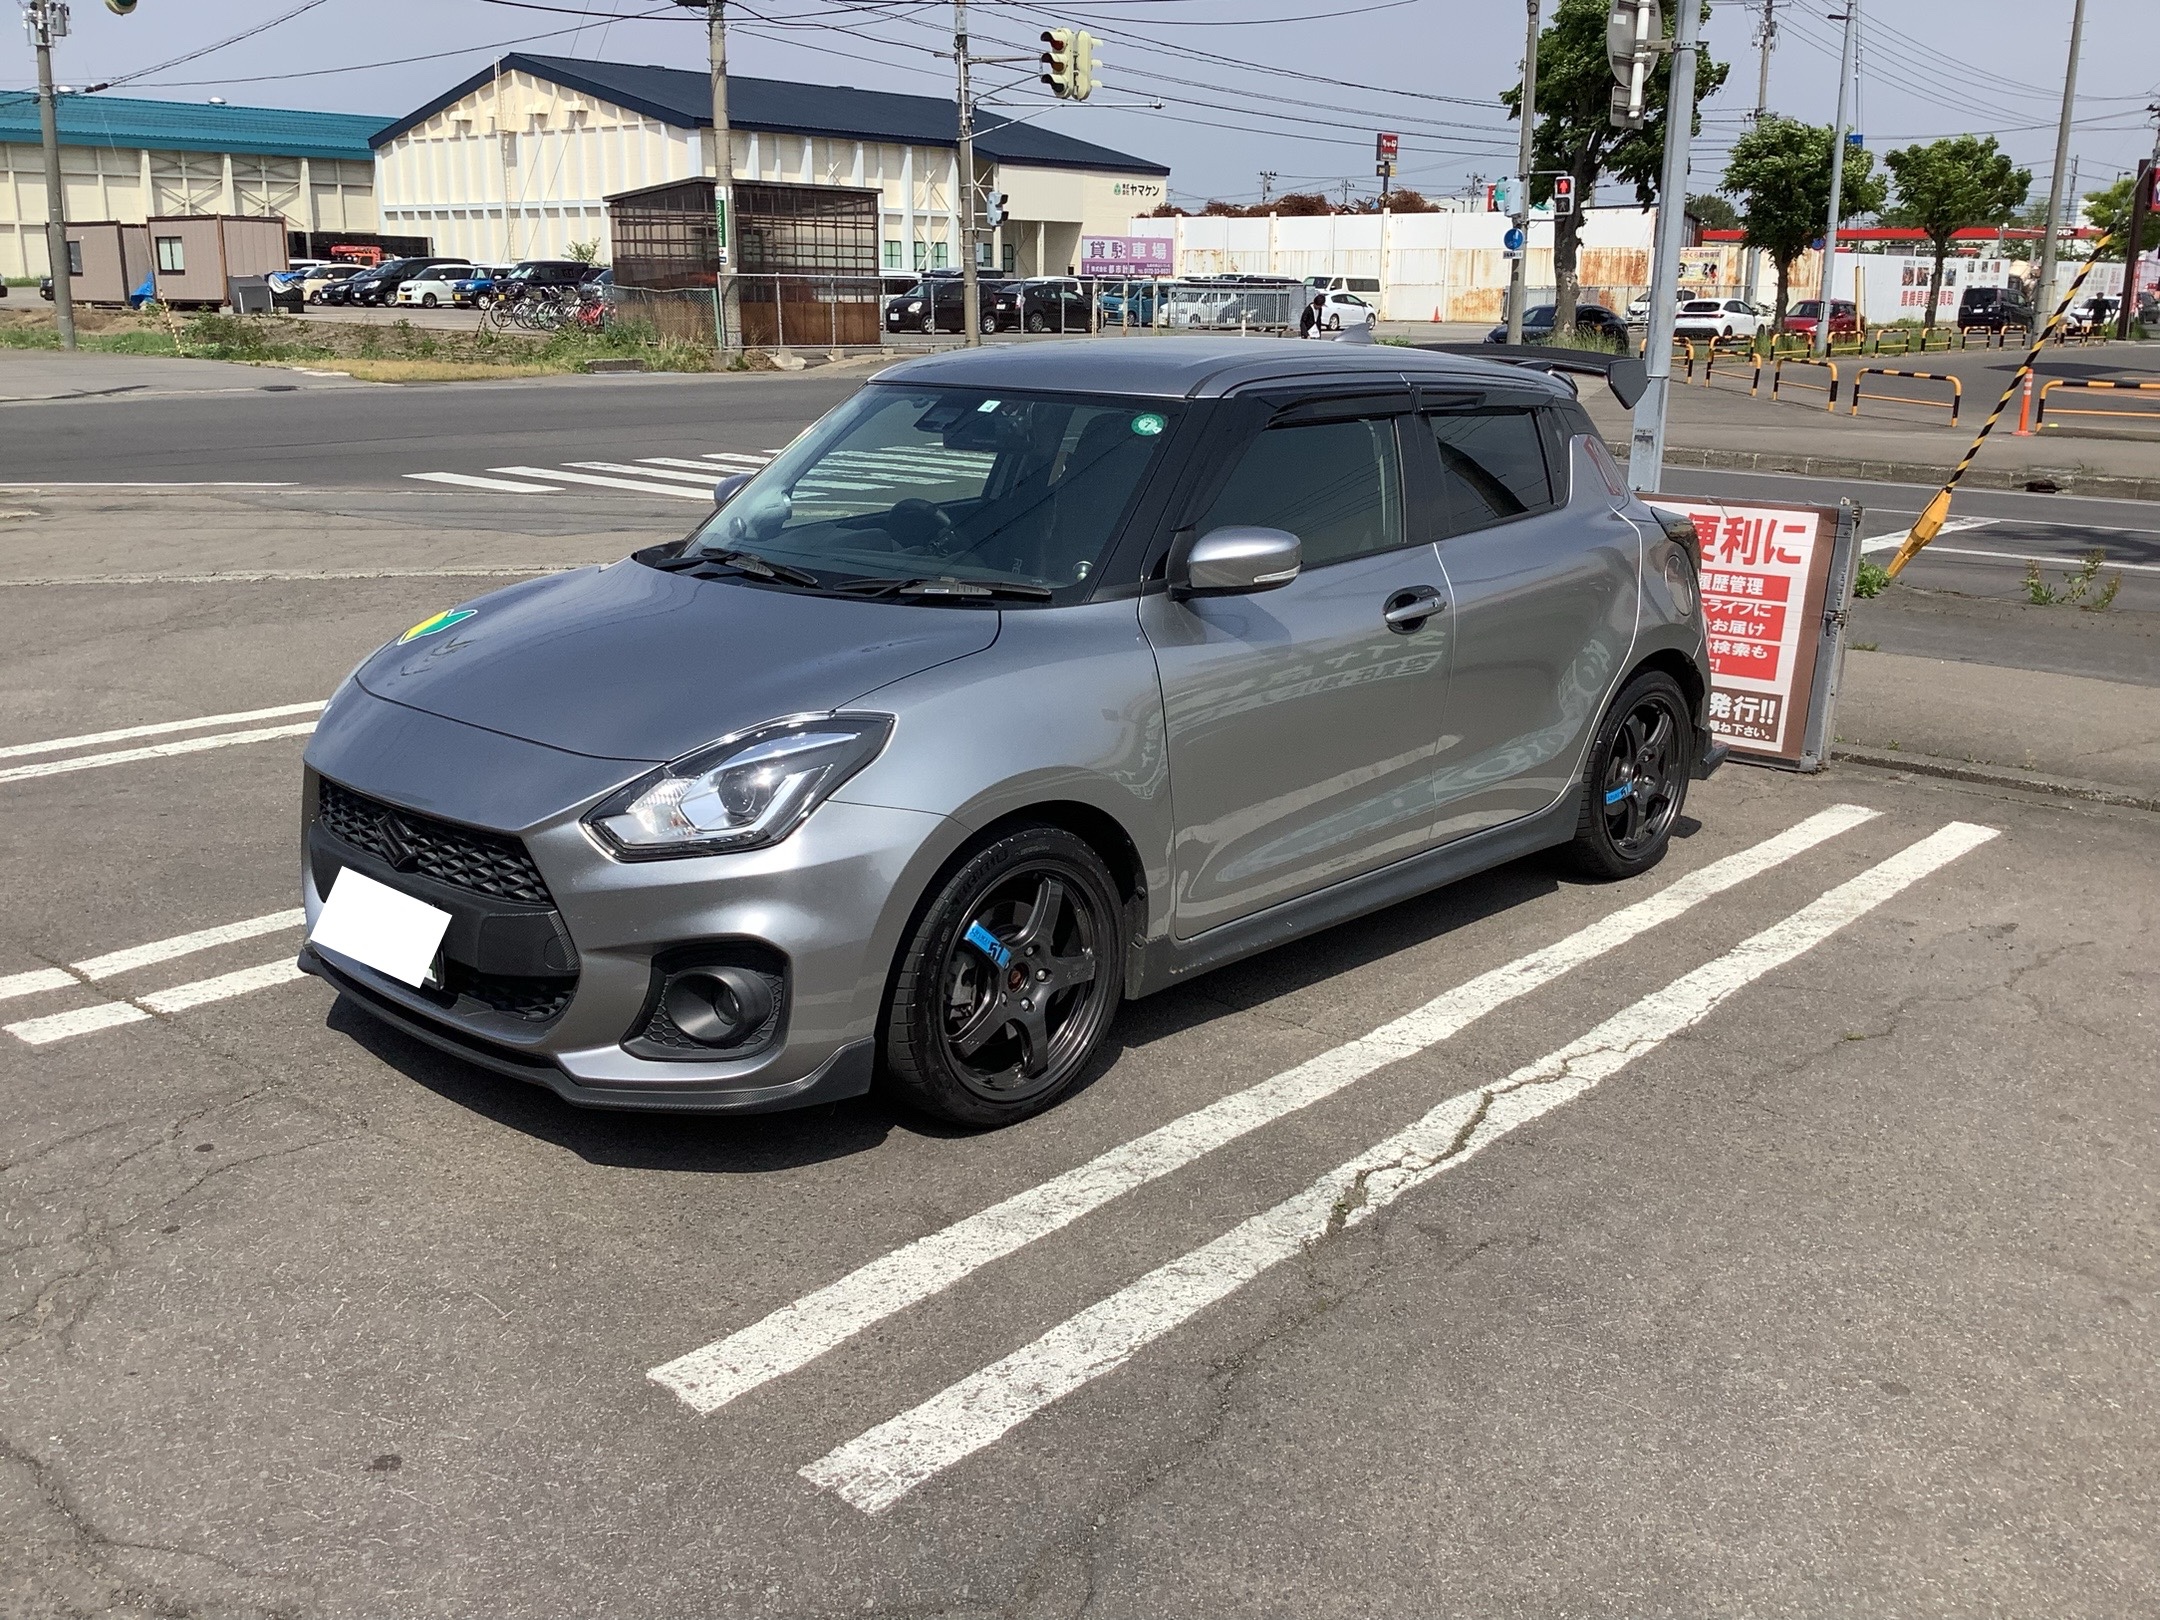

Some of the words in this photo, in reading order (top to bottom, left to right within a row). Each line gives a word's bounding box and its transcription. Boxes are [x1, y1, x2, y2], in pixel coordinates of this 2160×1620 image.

[1131, 184, 1160, 197] ヤマケン
[1090, 241, 1167, 260] 貸駐車場
[1689, 512, 1806, 566] 便利に
[1708, 618, 1766, 636] お届け
[1709, 639, 1768, 659] 検索も
